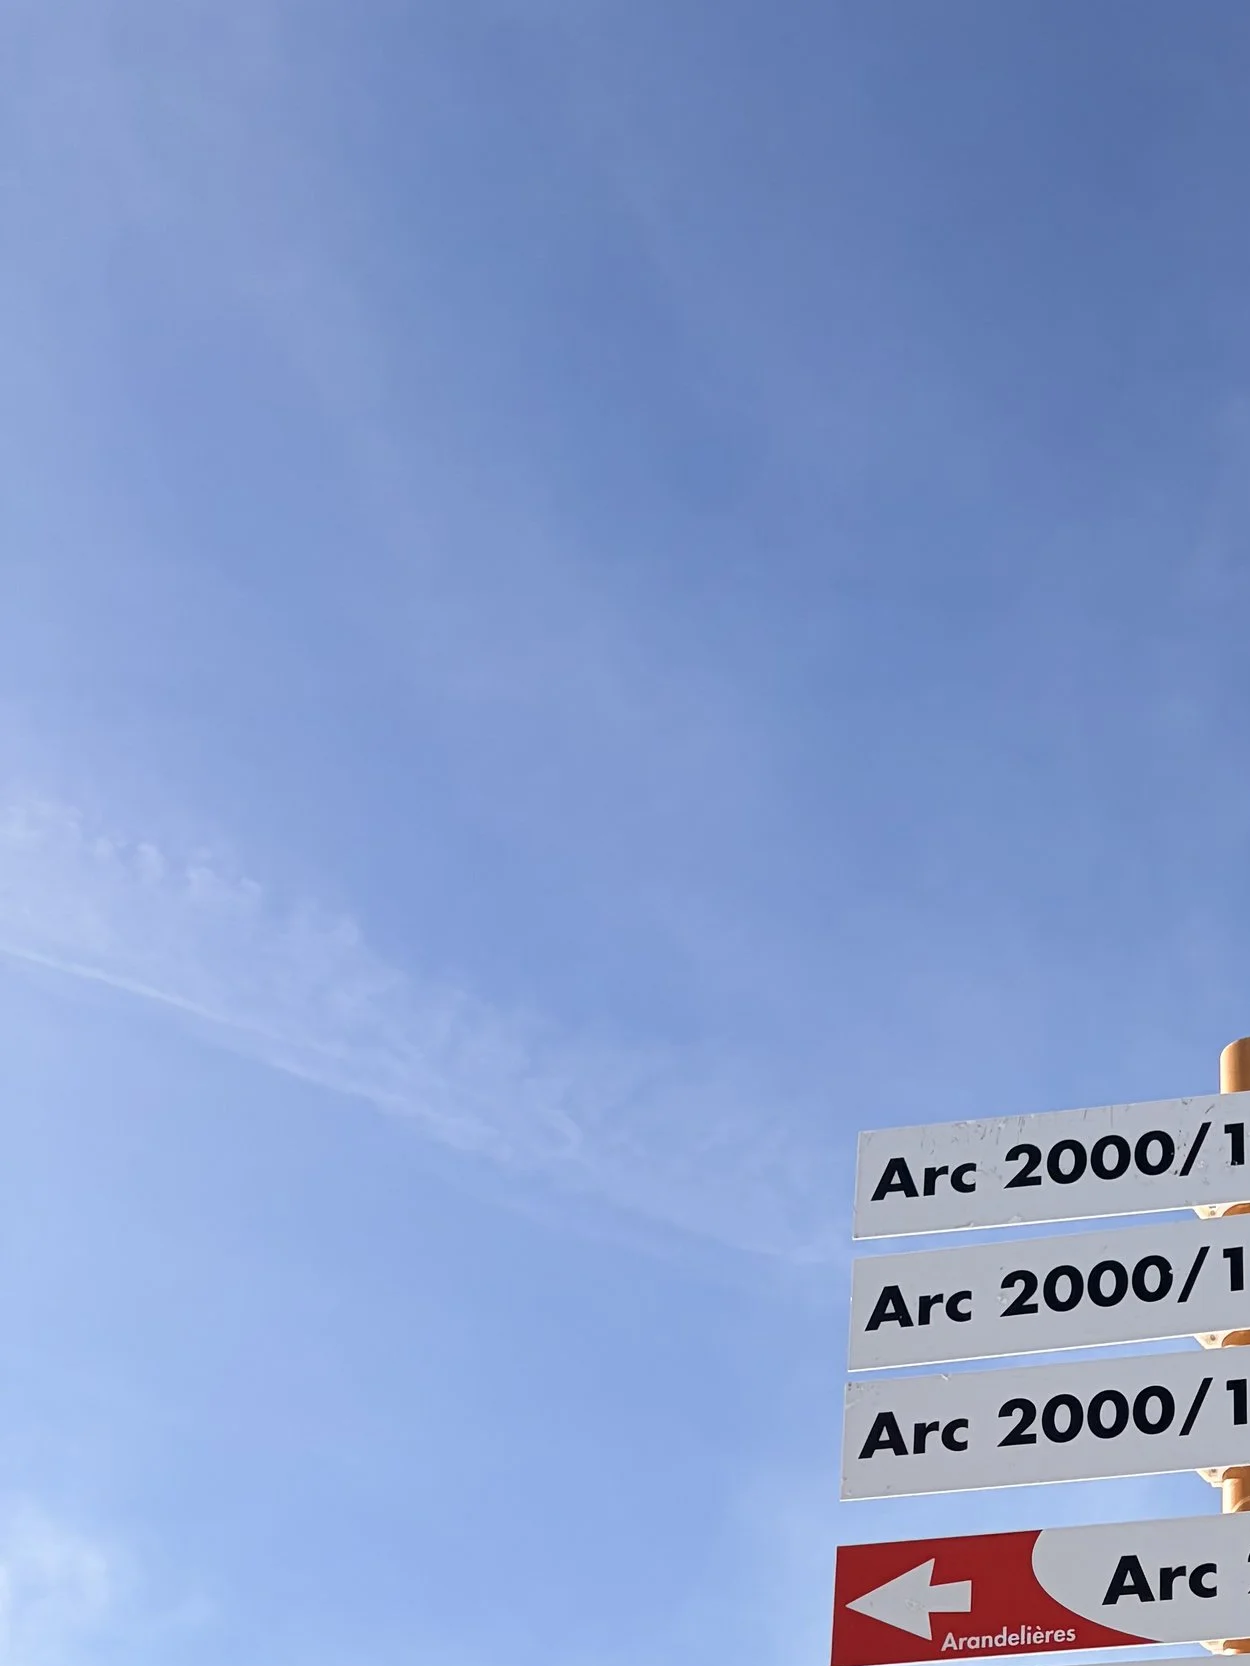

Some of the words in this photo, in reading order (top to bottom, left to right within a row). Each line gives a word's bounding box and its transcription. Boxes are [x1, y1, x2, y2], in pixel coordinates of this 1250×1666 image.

[870, 1157, 977, 1202] Arc
[864, 1284, 972, 1332] Arc
[857, 1411, 969, 1460] Arc
[1101, 1554, 1218, 1606] Arc
[940, 1624, 1077, 1652] Arandelières
